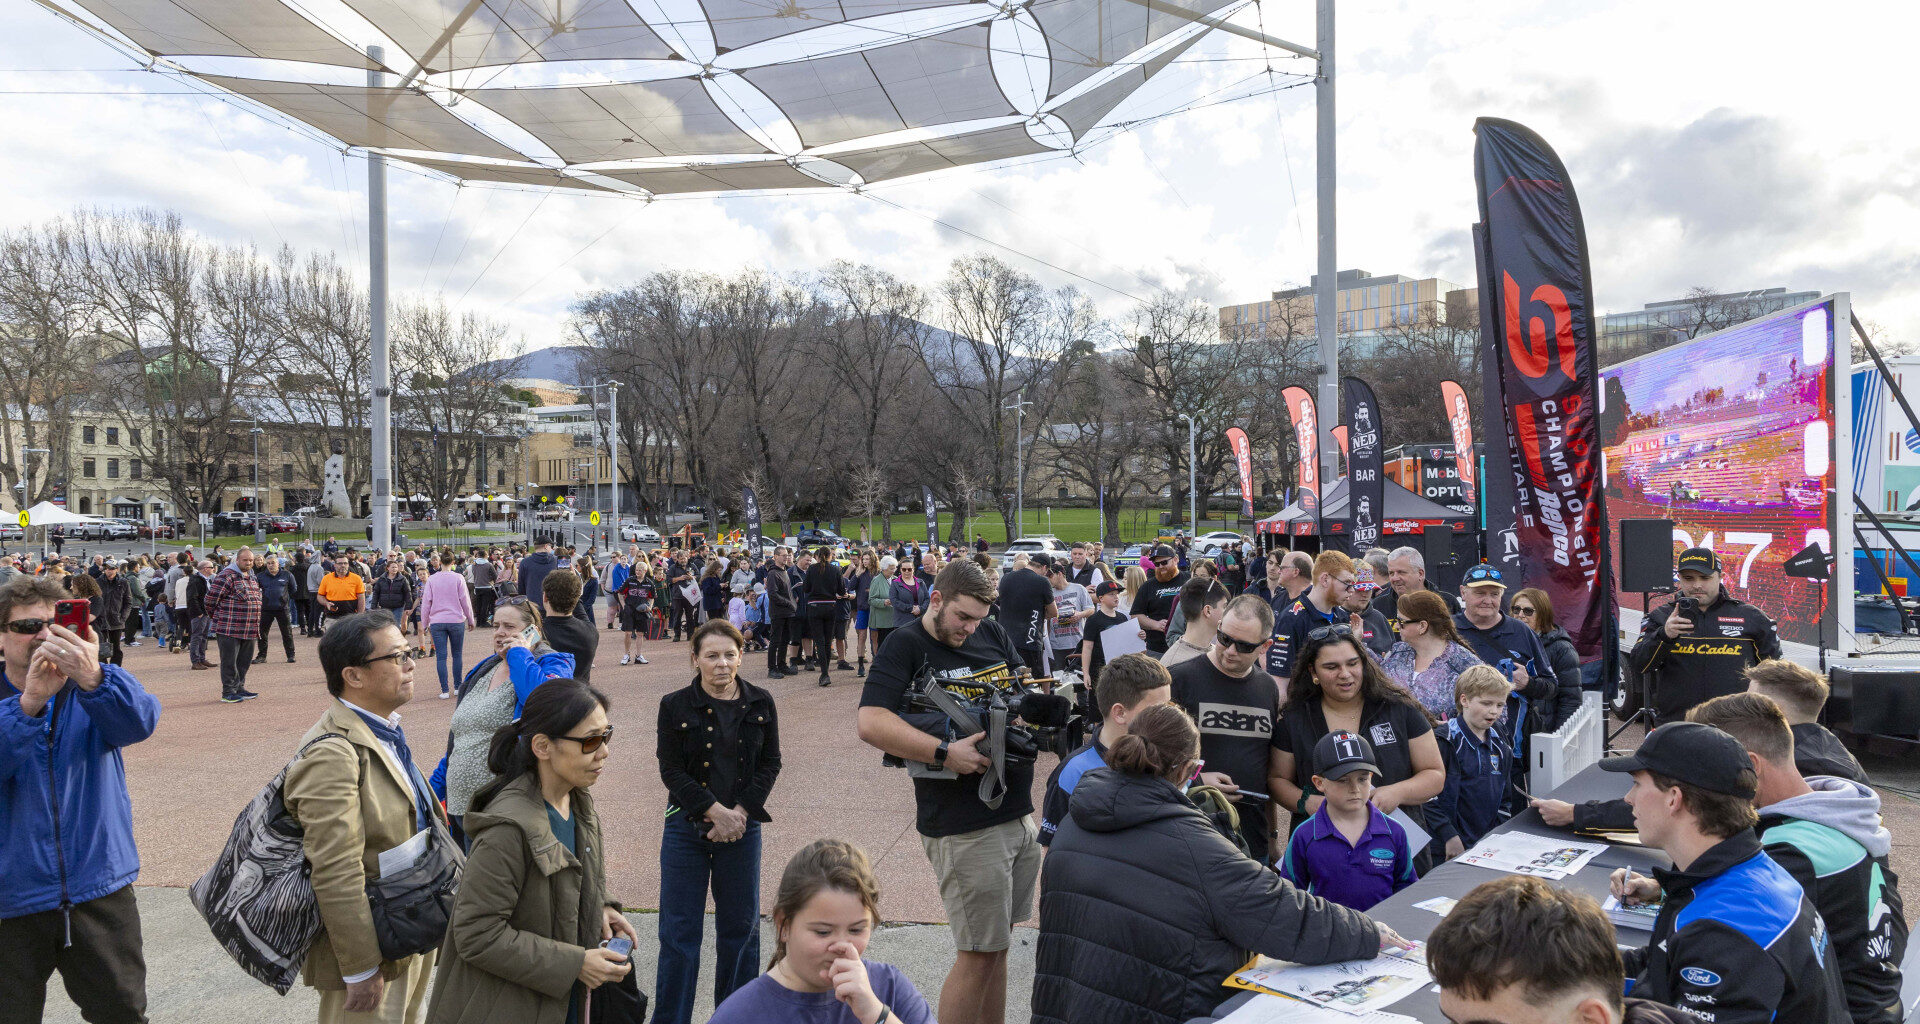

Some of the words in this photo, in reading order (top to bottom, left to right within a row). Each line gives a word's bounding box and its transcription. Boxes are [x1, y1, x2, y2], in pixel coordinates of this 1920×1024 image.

[1353, 433, 1377, 449] NED
[1356, 469, 1375, 482] BAR
[1426, 486, 1463, 498] OPTU
[1383, 520, 1419, 529] SuperKids
[1534, 487, 1570, 567] Repco
[1354, 528, 1377, 542] NED
[1697, 643, 1743, 656] Cadet
[1201, 710, 1271, 734] astars
[1333, 733, 1358, 743] Mobil
[1342, 741, 1354, 757] 1
[1687, 969, 1711, 983] Ford
